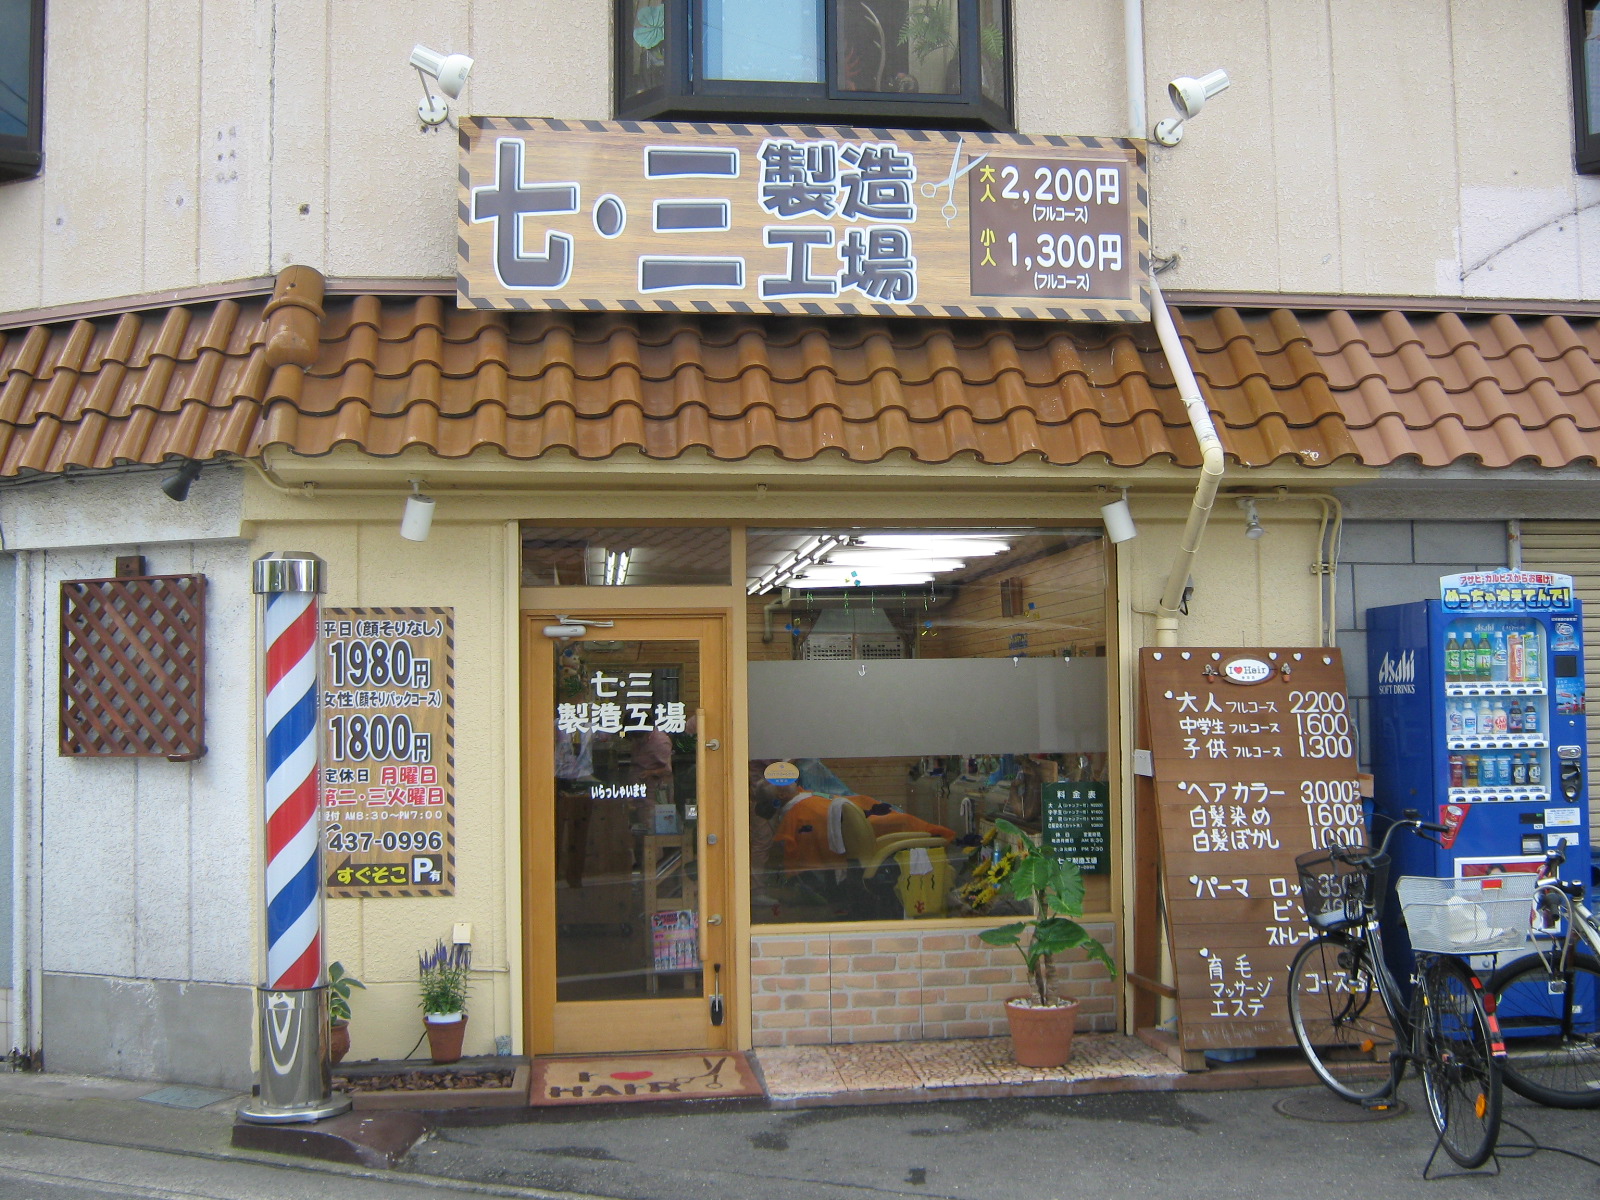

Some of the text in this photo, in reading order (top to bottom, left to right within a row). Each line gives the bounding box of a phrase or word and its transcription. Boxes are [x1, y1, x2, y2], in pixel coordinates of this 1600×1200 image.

[759, 141, 916, 222] 製造
[980, 164, 1120, 206] 大人 2,200円
[1032, 206, 1088, 223] (フルコース)
[981, 227, 1121, 271] 小人 1,300円
[759, 226, 917, 303] 工場
[1033, 271, 1089, 290] (フルコース)
[330, 639, 431, 689] 1980円
[1379, 650, 1414, 683] Asahi
[590, 671, 653, 698] 七・三
[1379, 684, 1415, 694] SOFT DRINKS
[1177, 691, 1345, 714] 大人 フルコース 2200
[557, 701, 686, 734] 製造工場
[1179, 717, 1225, 735] 中学生
[1229, 723, 1281, 734] フルコース
[330, 714, 431, 763] 1800円
[1183, 739, 1228, 759] 子供
[1233, 745, 1283, 758] フルコース
[326, 766, 437, 785] 定休日 月曜日
[591, 783, 647, 799] いらっしゃいませ
[1187, 782, 1285, 804] ヘアカラー
[1190, 806, 1271, 828] 白髪染め
[329, 832, 443, 852] 437-0996
[1192, 829, 1279, 852] 白髪ぼかし
[337, 866, 406, 884] すぐそこ
[1195, 877, 1249, 898] パーマ
[1265, 926, 1319, 946] ストレート
[1209, 954, 1252, 980] 育毛
[1210, 977, 1273, 998] マッサージ
[1211, 1000, 1265, 1017] エステ
[549, 1082, 682, 1098] HAIR
